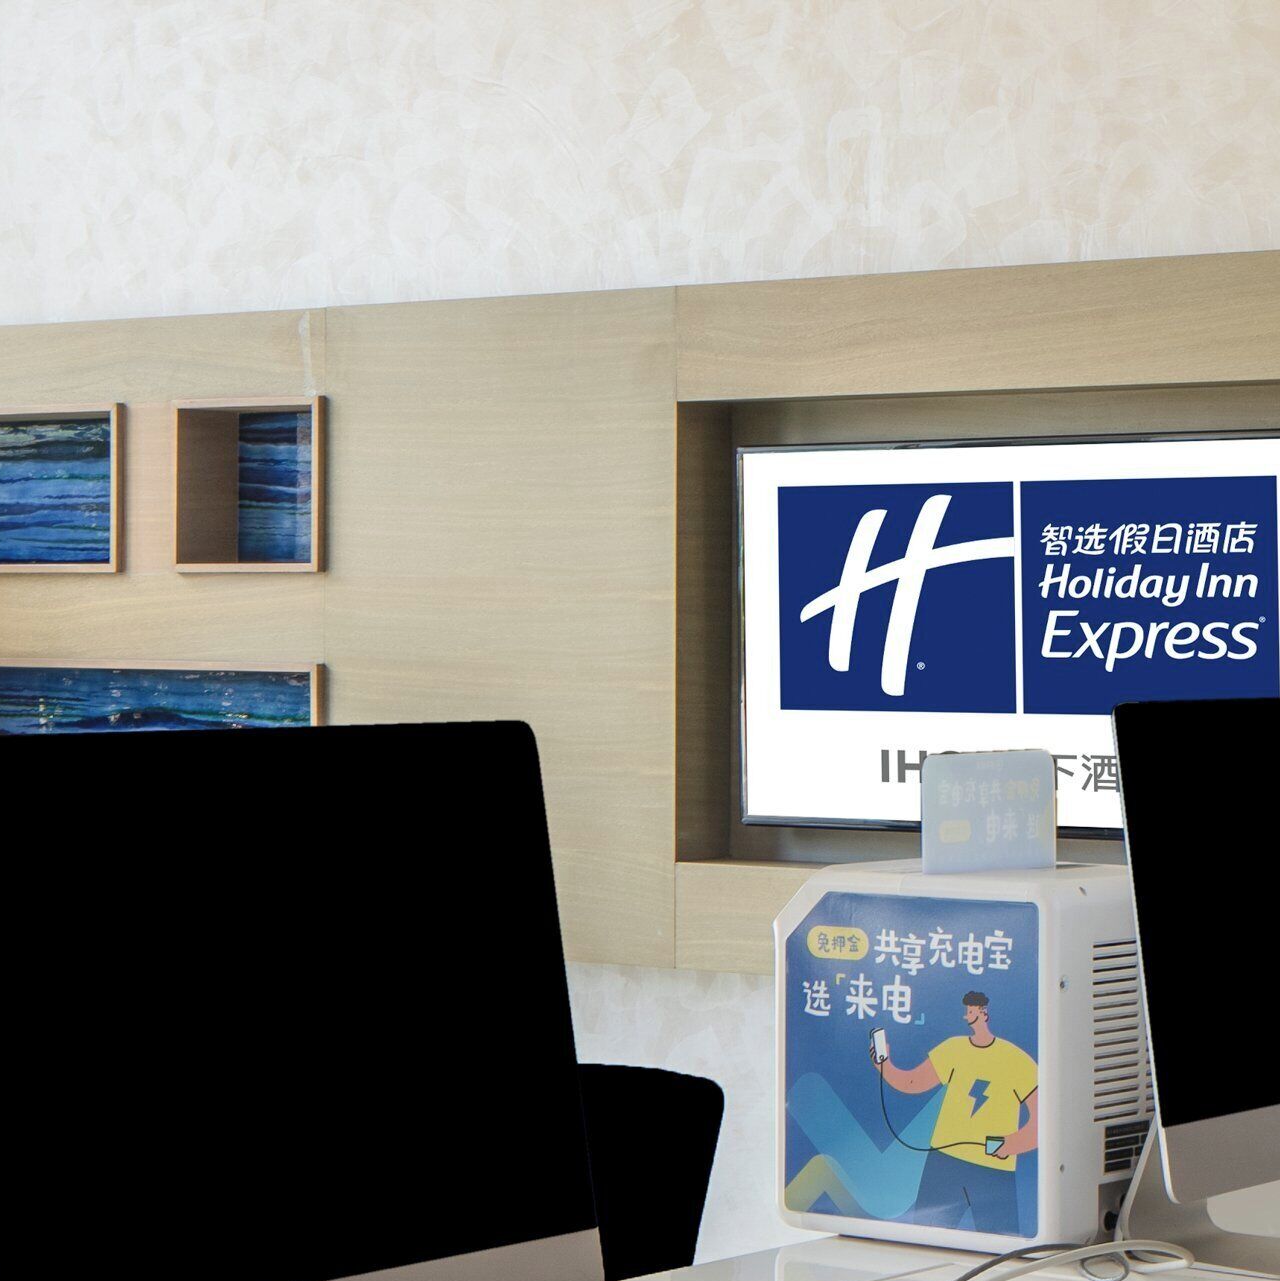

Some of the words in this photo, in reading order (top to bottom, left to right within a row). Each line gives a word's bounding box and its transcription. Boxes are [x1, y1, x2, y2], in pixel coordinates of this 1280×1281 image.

[1040, 521, 1258, 557] 智选假日酒店
[1038, 563, 1190, 608] Holiday
[1195, 562, 1259, 599] Inn
[1041, 609, 1261, 673] Express
[817, 932, 861, 953] 免押金
[874, 926, 1013, 976] 共享充电宝
